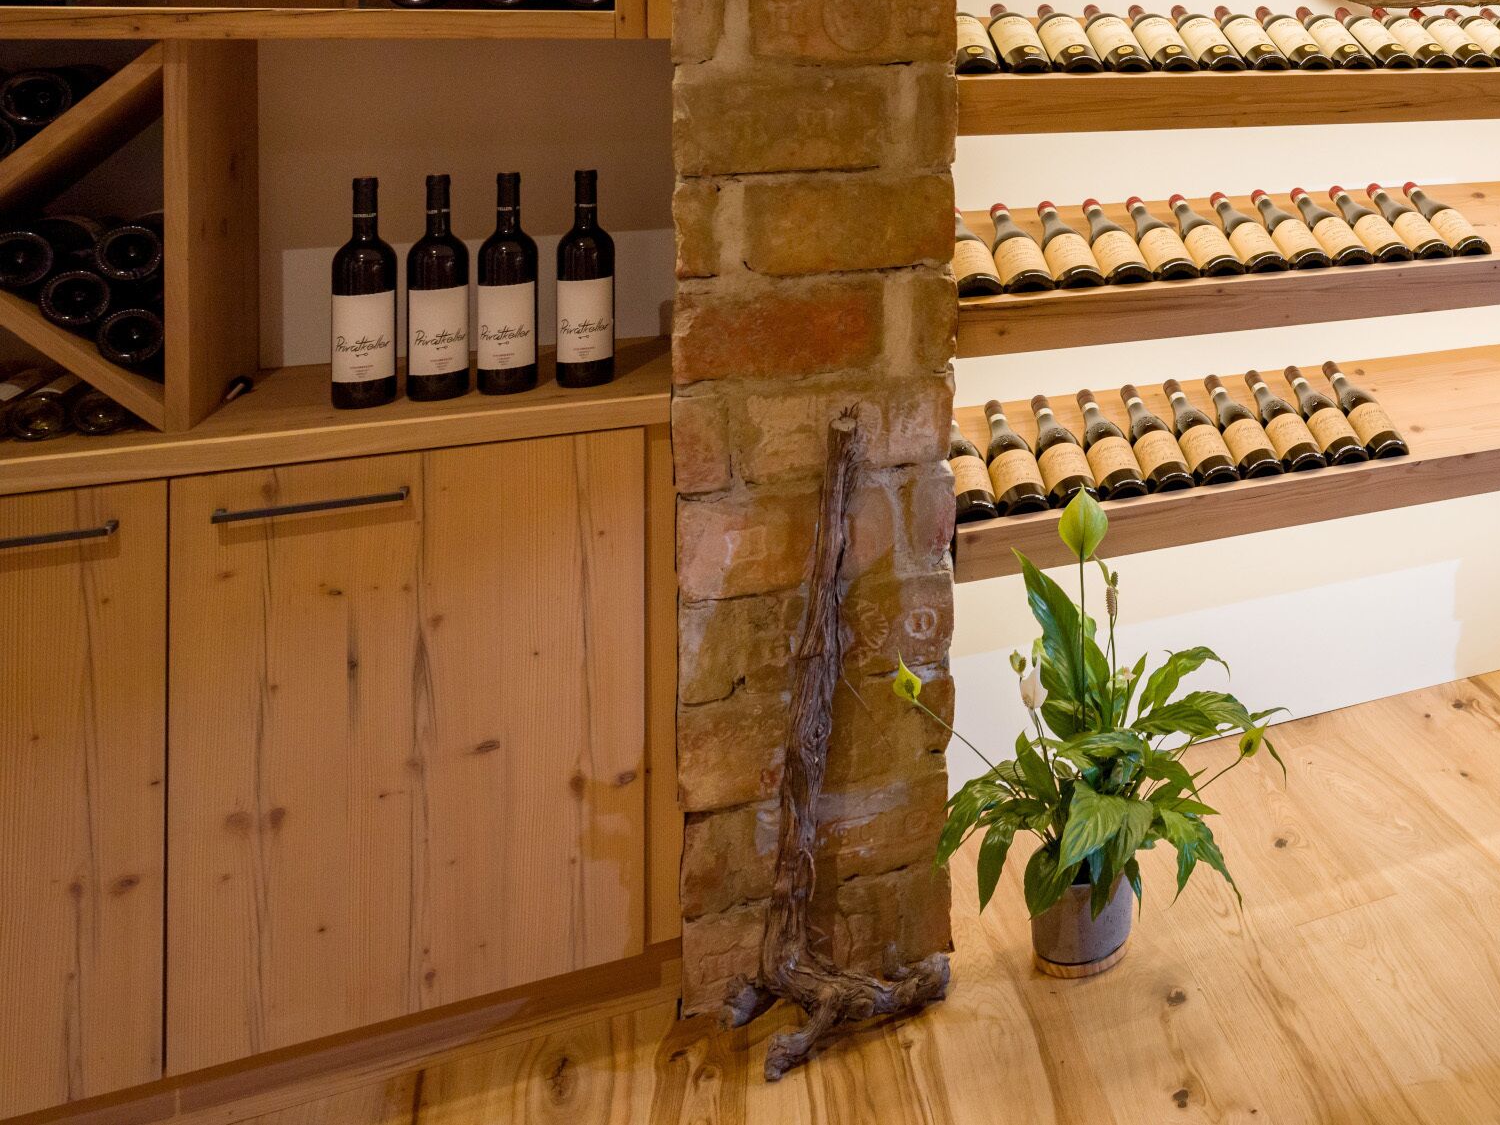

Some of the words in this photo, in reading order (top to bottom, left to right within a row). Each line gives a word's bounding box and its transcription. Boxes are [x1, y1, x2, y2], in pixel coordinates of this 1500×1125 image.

[480, 324, 531, 341] Privatkeller
[560, 316, 610, 335] Privatkeller
[335, 334, 391, 353] Privatkeller
[414, 328, 466, 346] Privatkeller
